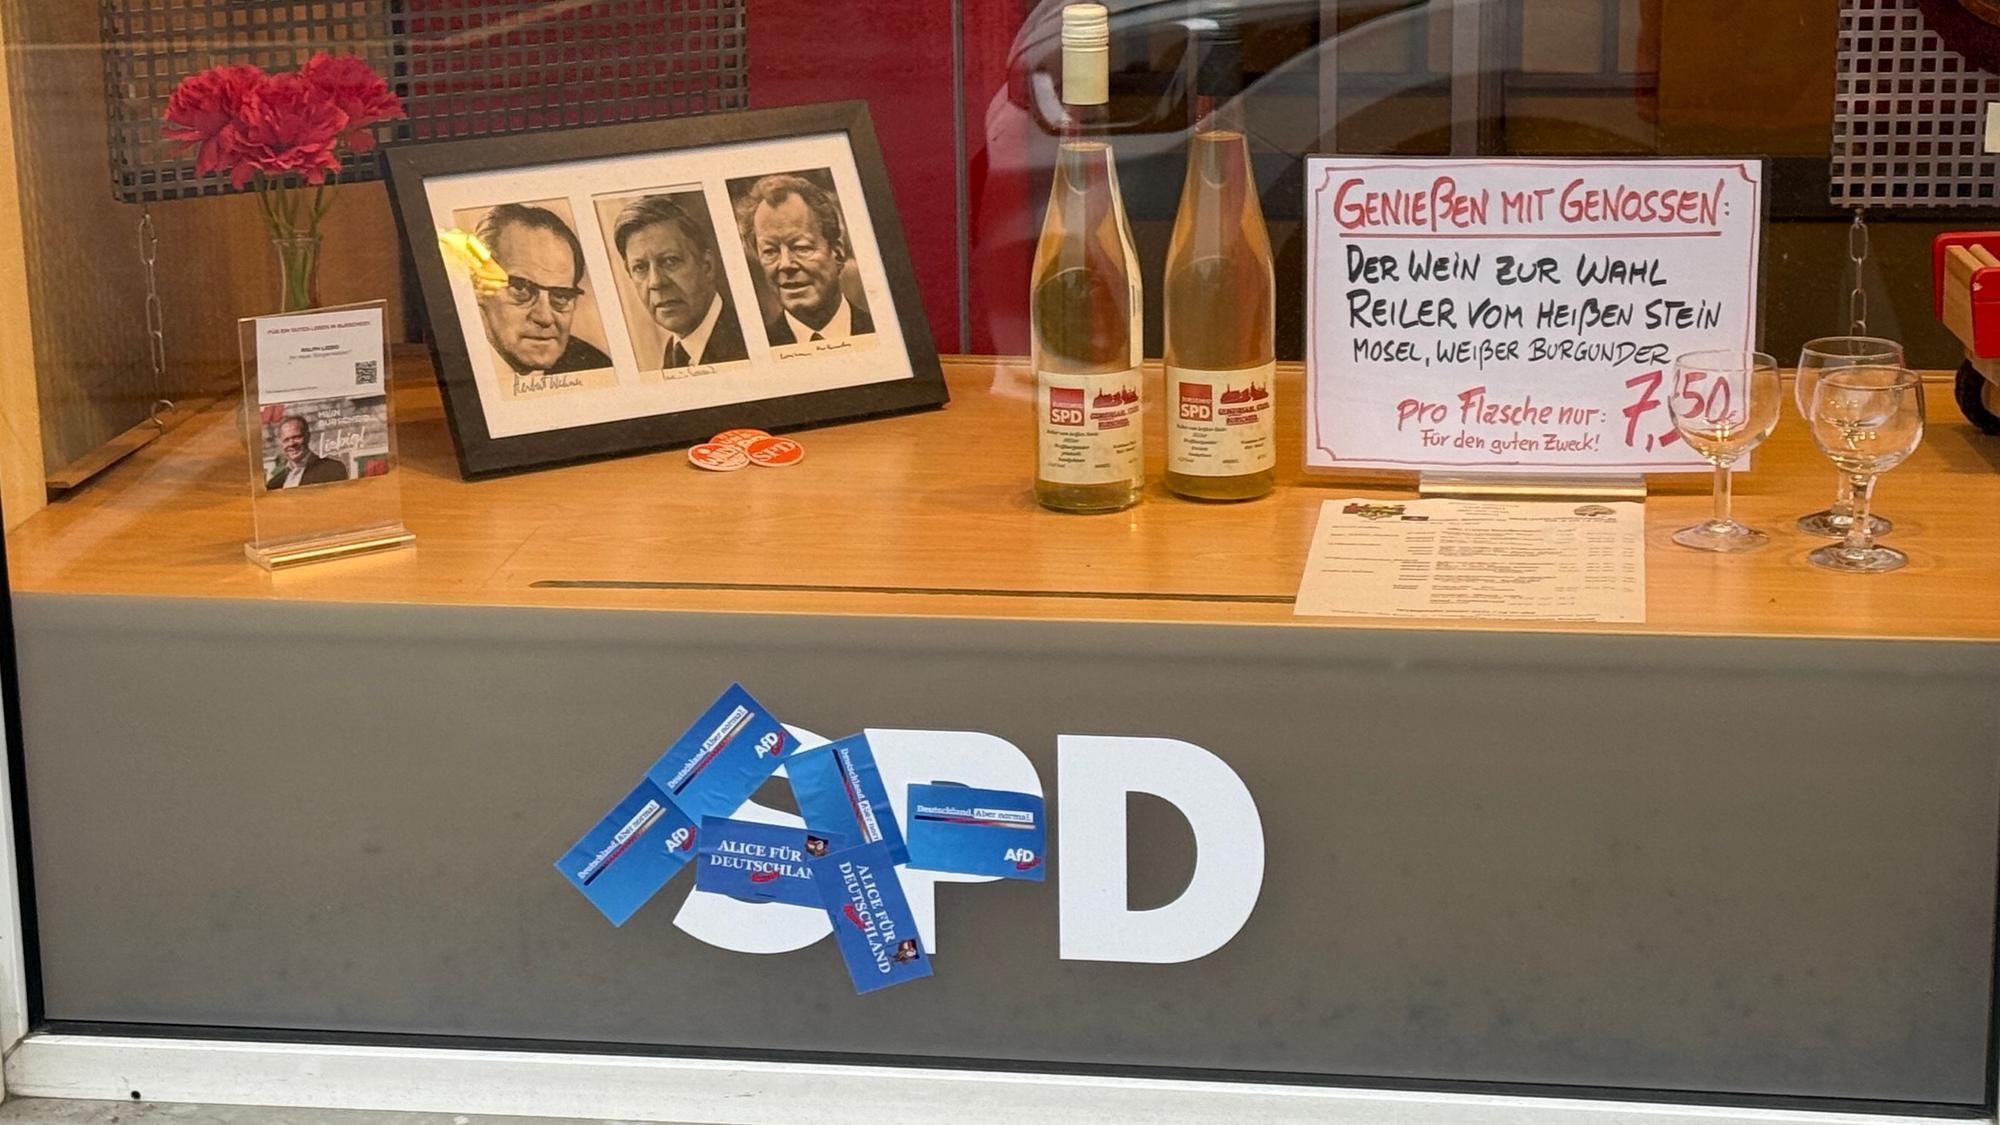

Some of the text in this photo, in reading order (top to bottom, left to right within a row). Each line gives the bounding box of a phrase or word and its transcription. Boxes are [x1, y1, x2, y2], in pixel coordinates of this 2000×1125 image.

[1501, 188, 1555, 225] MIT
[1559, 178, 1730, 226] GENOSSEN:
[1346, 244, 1667, 287] DER WEIN ZUR WAHL
[1346, 288, 1457, 330] REILER
[1468, 297, 1524, 329] VOM
[1645, 298, 1722, 330] STEIN
[1353, 337, 1430, 367] MOSEL,
[1528, 337, 1672, 367] BURGUNDER
[1051, 409, 1083, 424] SPD
[1181, 404, 1211, 419] SPD
[1396, 386, 1607, 432] pro Flasche nur:
[751, 441, 796, 462] SPD
[1421, 429, 1600, 455] Für den guten Zweck!
[706, 732, 723, 750] Aber
[754, 732, 779, 759] AfD
[975, 809, 996, 819] Aber
[665, 828, 690, 853] AfD
[717, 840, 803, 863] ALICE FÜR
[710, 855, 814, 880] DEUTSCHLAN
[1004, 848, 1034, 862] AfD
[856, 864, 896, 943] ALICE FÜR
[839, 862, 892, 974] DEUTSCHLAND
